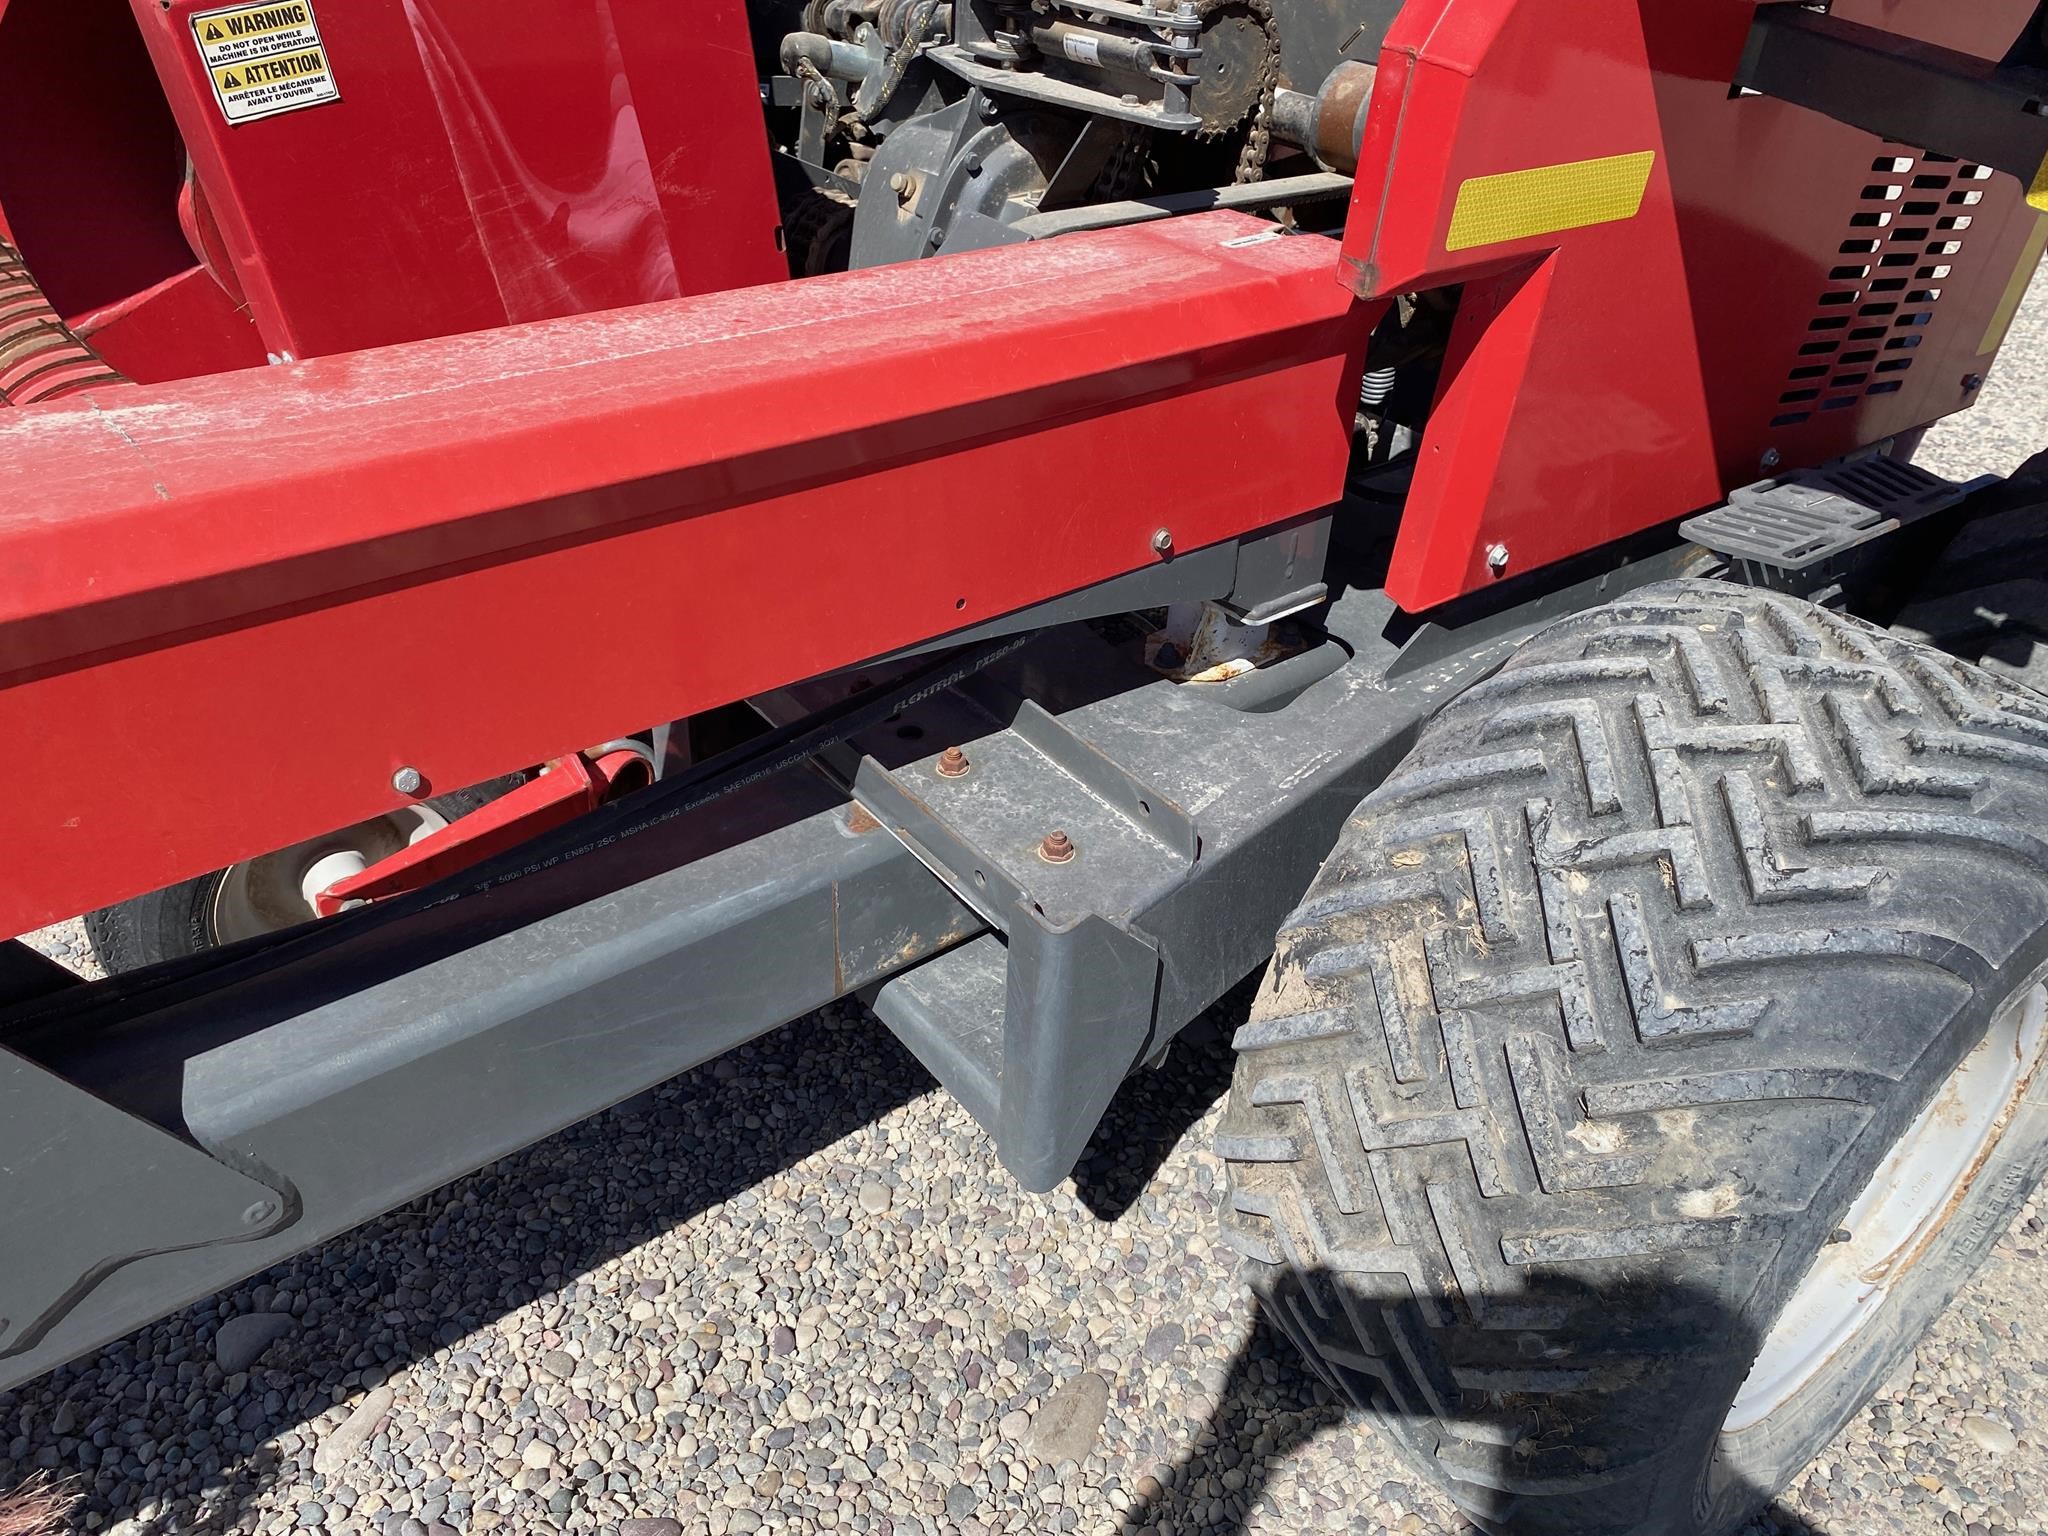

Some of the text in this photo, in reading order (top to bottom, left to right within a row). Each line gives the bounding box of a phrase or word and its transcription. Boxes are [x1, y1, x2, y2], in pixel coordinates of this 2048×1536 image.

[224, 5, 306, 36] WARNING
[209, 35, 317, 63] MACHINE IS IN OPERATION
[219, 29, 303, 53] DO NOT OPEN WHILE
[244, 52, 323, 85] ATTENTION
[228, 75, 327, 103] ARRÊTER LE MÉCANISME
[247, 95, 273, 107] AVANT
[275, 86, 314, 100] D'OUVRIR
[498, 869, 523, 884] 5000
[523, 862, 542, 876] PSI
[542, 855, 560, 869] WP
[564, 842, 596, 861] EN857
[597, 834, 618, 848] 2SC
[620, 821, 649, 839] MSHA
[684, 791, 721, 812] Exceeds
[723, 768, 772, 794] SAE100R16
[775, 748, 811, 770] USCG-H
[1944, 1163, 2027, 1280] IMPLEMENT
